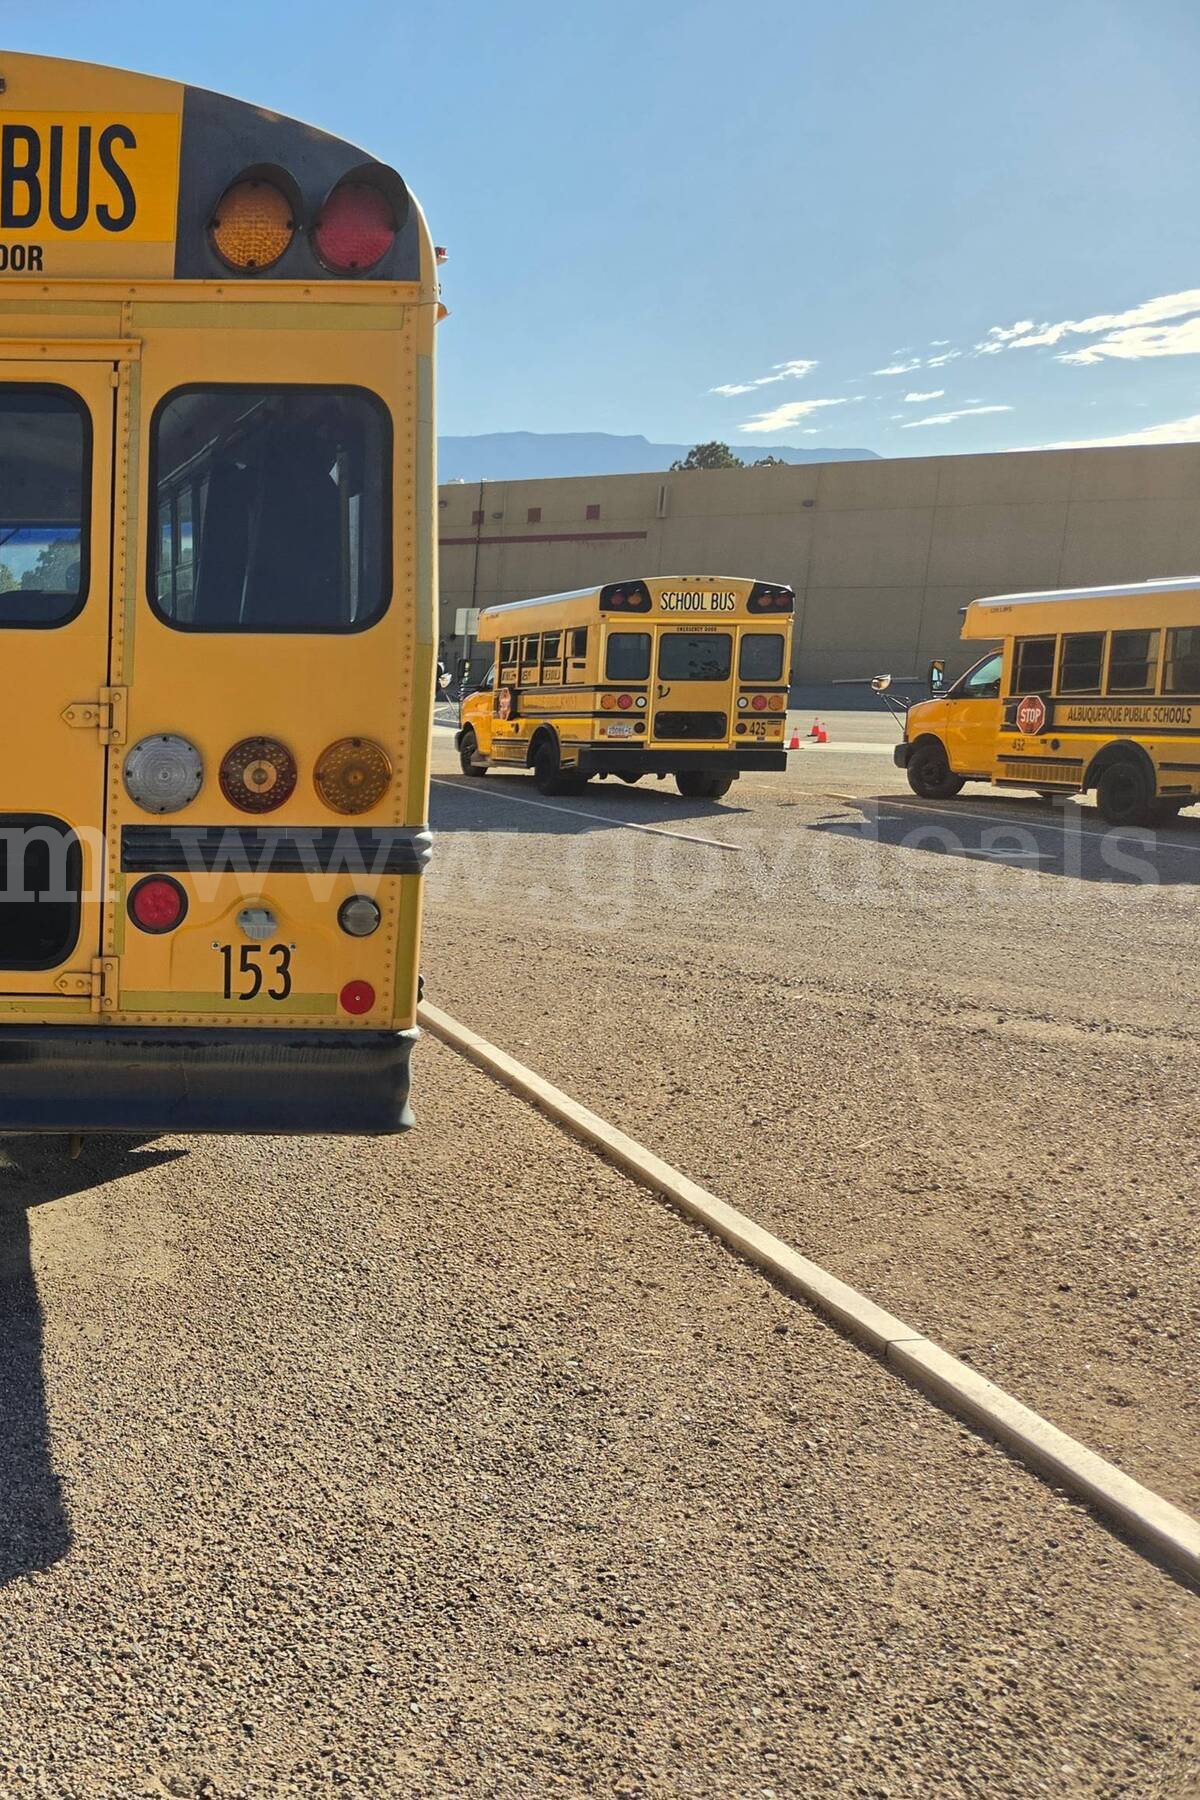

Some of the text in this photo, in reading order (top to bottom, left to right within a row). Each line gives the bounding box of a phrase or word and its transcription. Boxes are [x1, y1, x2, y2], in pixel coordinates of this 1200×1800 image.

[0, 123, 137, 232] BUS
[660, 592, 735, 610] SCHOOL BUS
[1020, 708, 1042, 723] STOP
[1068, 707, 1192, 724] ALBUQUERQUE PUBLIC SCHOOLS
[749, 721, 766, 736] 425
[220, 943, 292, 1001] 153
